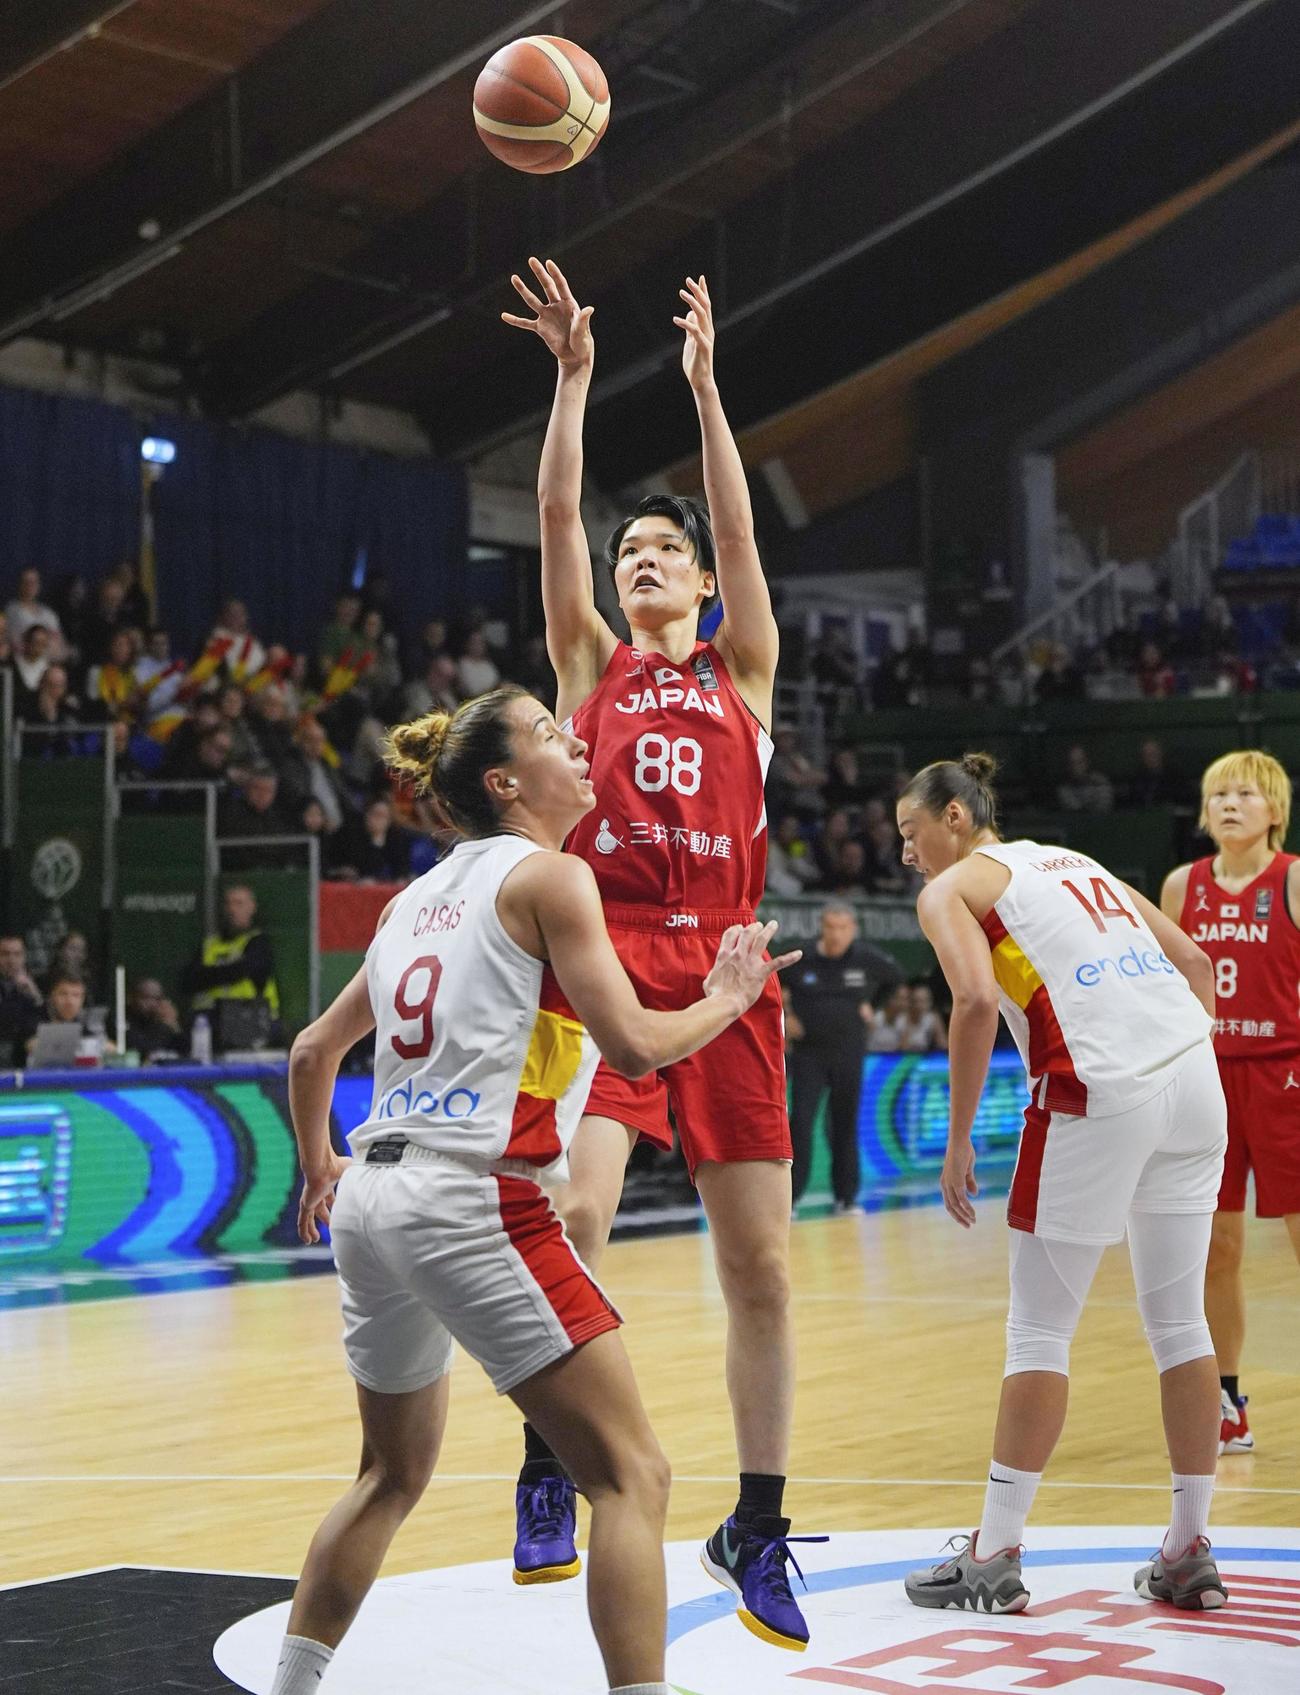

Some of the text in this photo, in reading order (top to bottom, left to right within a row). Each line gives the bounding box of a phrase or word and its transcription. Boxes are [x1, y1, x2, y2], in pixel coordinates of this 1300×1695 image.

[615, 688, 725, 718] JAPAN
[634, 732, 703, 797] 88
[629, 822, 733, 859] 三井不動産
[413, 900, 465, 937] CASAS
[665, 914, 698, 928] JPN
[1061, 877, 1140, 934] 14
[1192, 922, 1268, 943] JAPAN
[1215, 957, 1238, 999] 8
[391, 954, 443, 1061] 9
